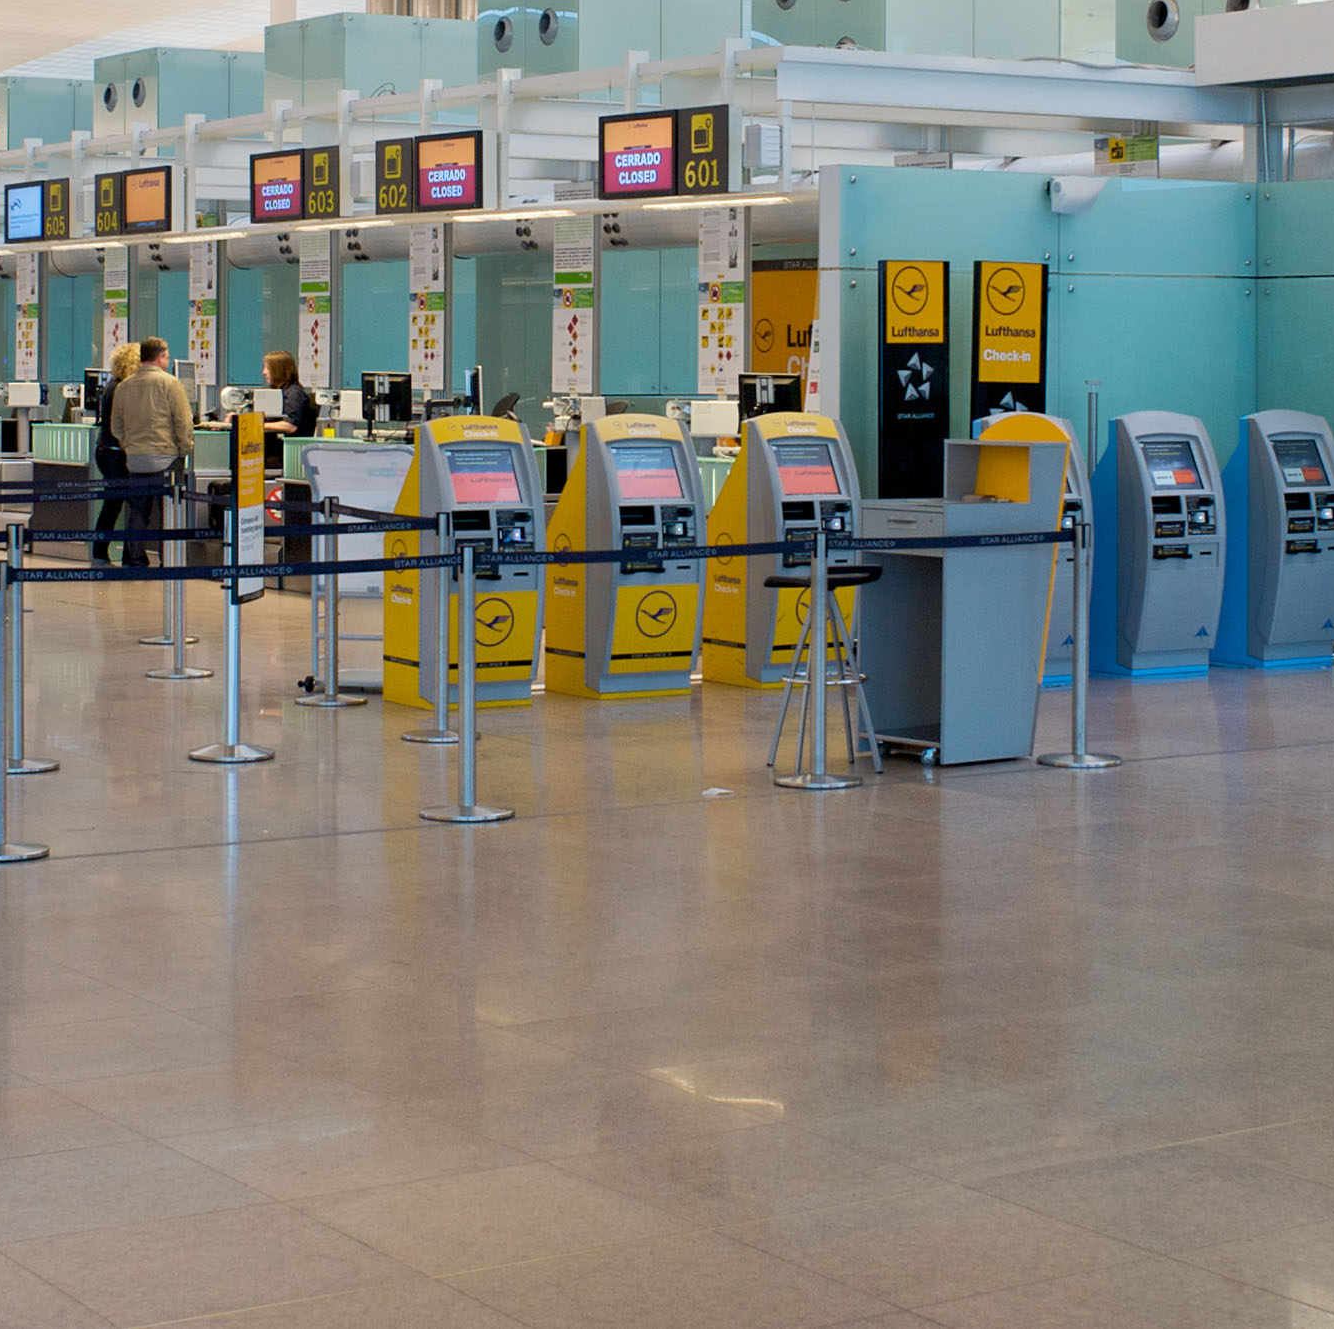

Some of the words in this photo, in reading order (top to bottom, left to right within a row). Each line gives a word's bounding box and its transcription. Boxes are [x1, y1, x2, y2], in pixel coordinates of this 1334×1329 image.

[615, 152, 660, 168] CERRADO
[428, 169, 466, 183] CERRADO
[619, 169, 657, 185] CLOSED
[685, 159, 719, 189] 601
[262, 184, 293, 197] CERRADO
[379, 184, 407, 208] 602
[431, 185, 463, 199] CLOSED
[264, 198, 290, 210] CLOSED
[308, 190, 334, 214] 603
[46, 215, 66, 236] 605
[97, 211, 118, 232] 604
[891, 326, 940, 338] Lufthansa
[985, 325, 1036, 338] Lufthansa
[983, 349, 1031, 362] Check-in
[370, 523, 405, 531] ALLIANCE
[34, 532, 54, 540] STAR
[55, 532, 97, 540] ALLIANCE
[1003, 535, 1038, 543] ALLIANCE
[851, 540, 887, 548] ALLIANCE
[481, 554, 503, 562] STAR
[505, 553, 546, 562] ALLIANCE
[648, 551, 668, 560] STAR
[670, 549, 710, 558] ALLIANCE
[395, 559, 417, 568] STAR
[419, 556, 462, 566] ALLIANCE
[18, 571, 43, 580] STAR
[46, 571, 95, 580] ALLIANCE
[212, 568, 236, 576] STAR
[239, 566, 285, 575] ALLIANCE
